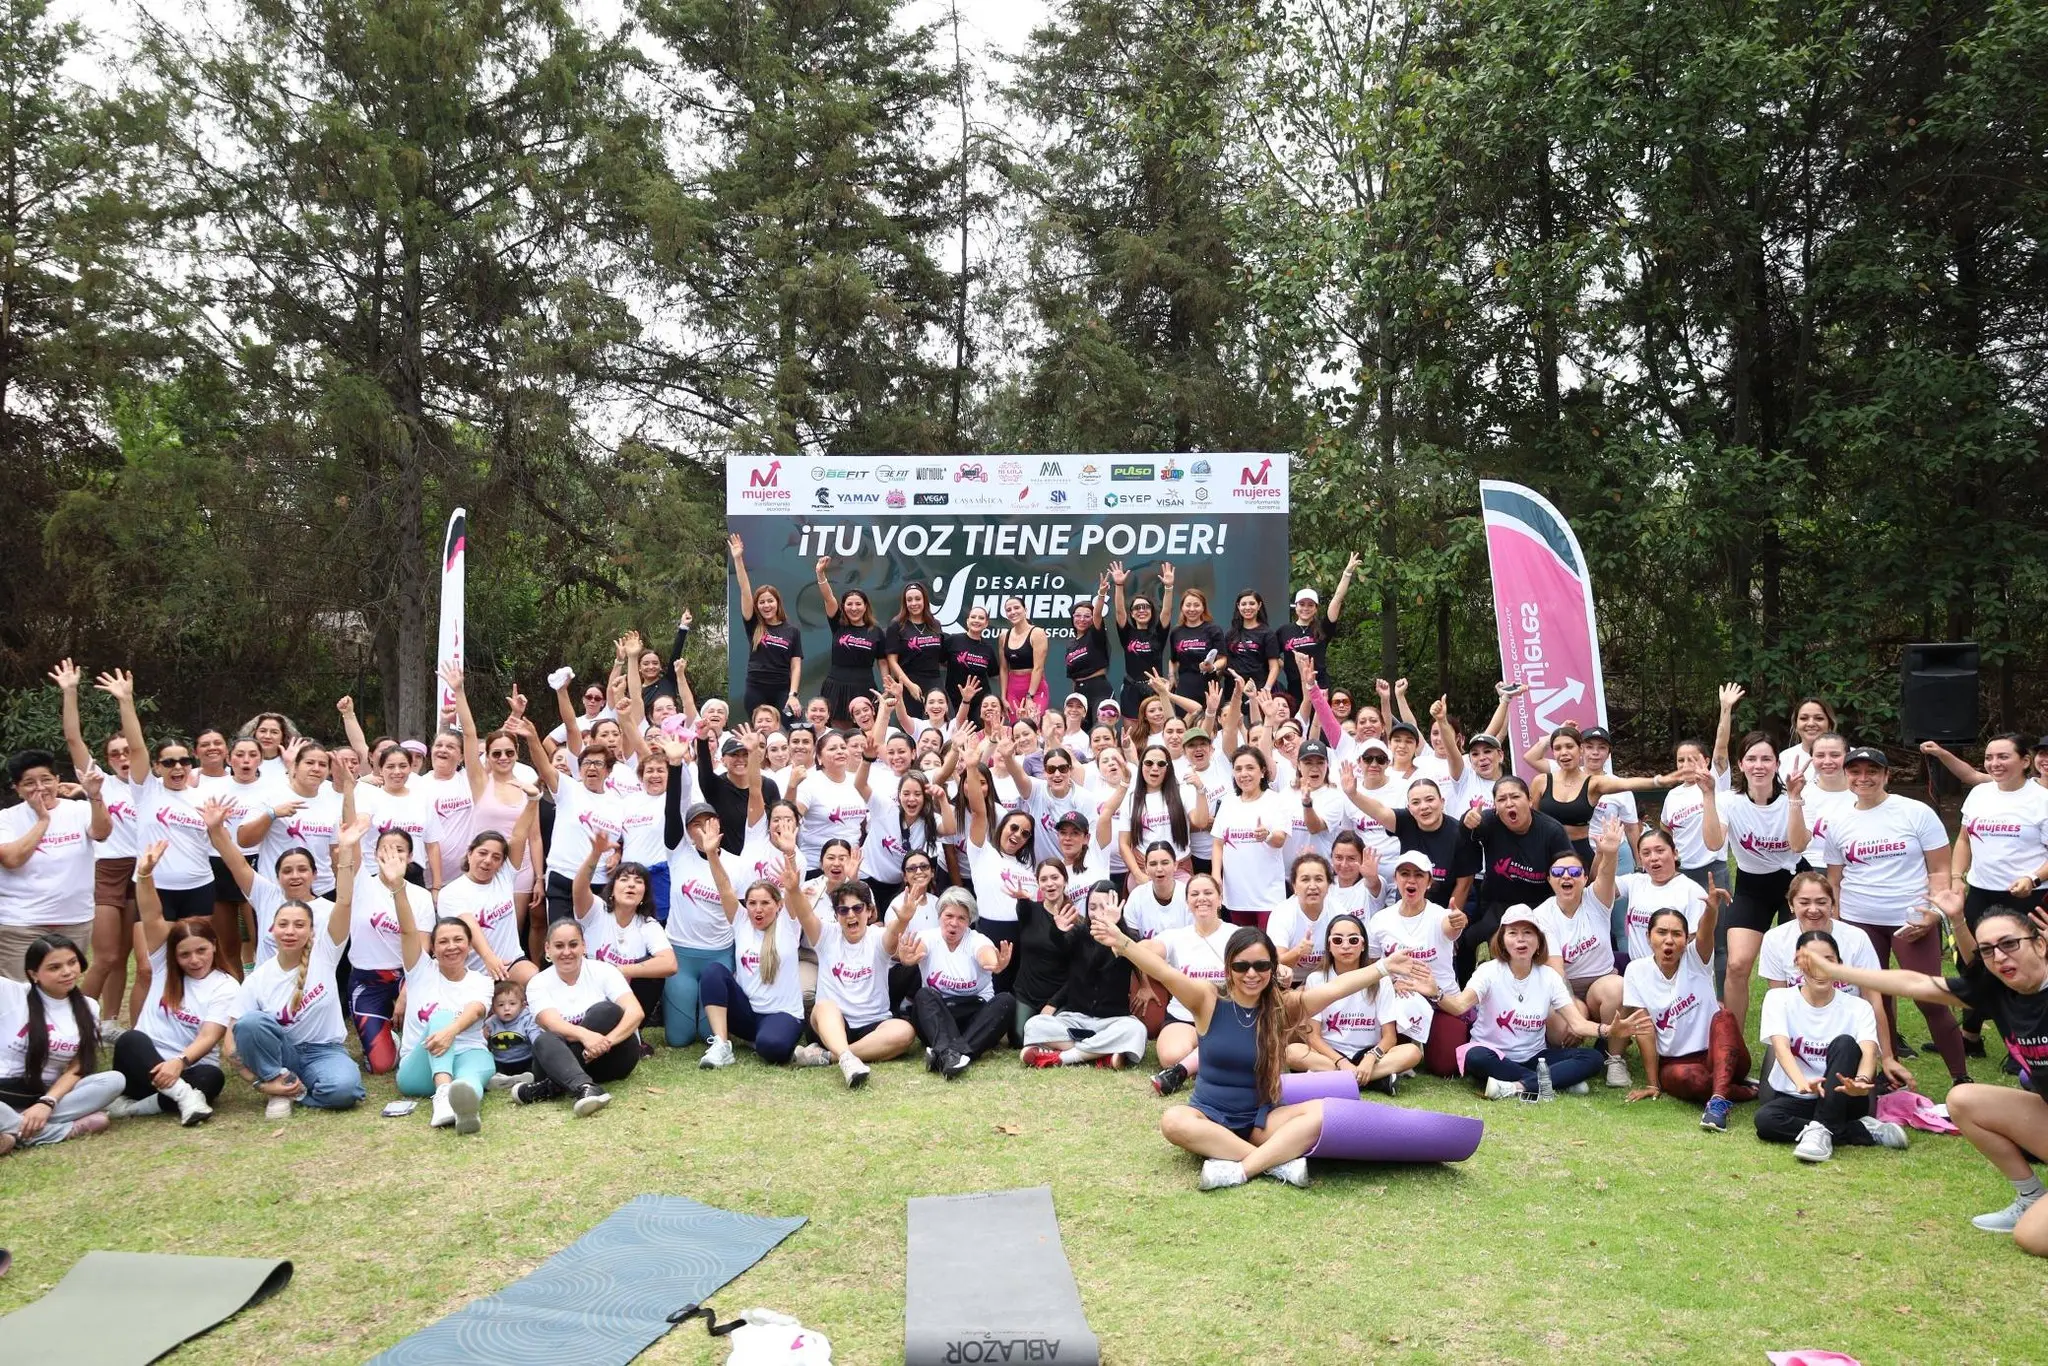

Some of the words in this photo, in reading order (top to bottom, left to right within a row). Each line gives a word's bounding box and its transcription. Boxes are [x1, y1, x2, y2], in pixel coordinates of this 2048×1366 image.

[826, 470, 869, 478] BEFIT
[1114, 466, 1151, 475] PULSO
[1161, 469, 1184, 480] JUMP
[742, 487, 791, 501] mujeres
[837, 494, 880, 502] YAMAV
[1051, 490, 1066, 502] SN
[1233, 486, 1281, 500] mujeres
[1120, 494, 1151, 503] SYEP
[1157, 498, 1185, 506] VISAN
[799, 525, 862, 556] ¡TU
[871, 525, 955, 556] VOZ
[963, 524, 1072, 556] TIENE
[1079, 523, 1228, 555] PODER!
[976, 573, 1065, 590] DESAFÍO
[1977, 824, 2021, 832] MUJERES
[40, 833, 81, 844] MUJERES
[1857, 841, 1907, 856] MUJERES
[693, 887, 722, 900] MUJER
[1632, 915, 1650, 924] MUJE
[939, 979, 977, 989] MUJERES
[1339, 1018, 1376, 1026] MUJERES
